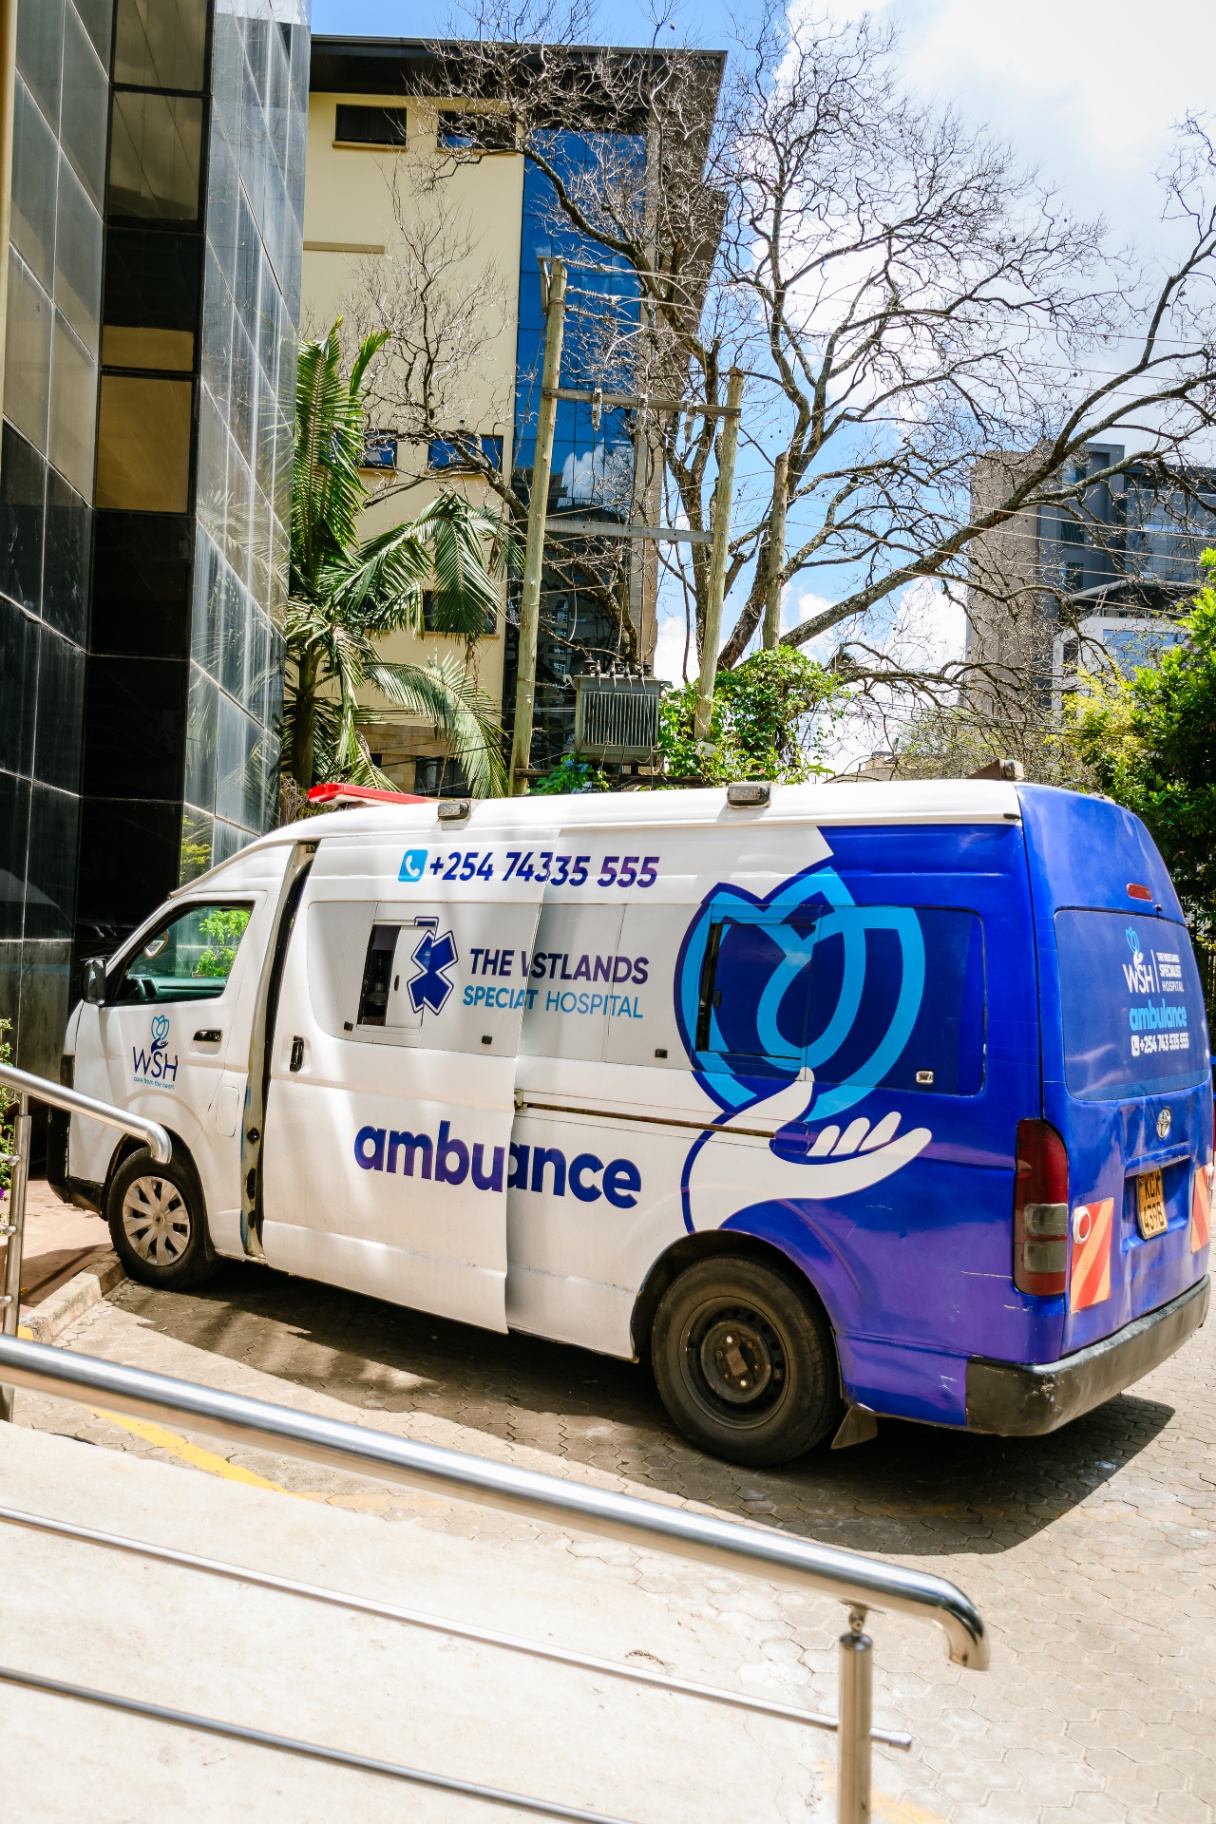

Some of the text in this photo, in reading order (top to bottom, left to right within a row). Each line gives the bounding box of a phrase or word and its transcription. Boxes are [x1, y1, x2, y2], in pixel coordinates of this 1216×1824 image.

[430, 852, 494, 881] +254
[597, 856, 660, 888] 555
[470, 948, 514, 977] THE
[1123, 964, 1154, 993] WSH
[1161, 980, 1185, 992] HOSPITAL
[545, 989, 644, 1019] HOSPITAL
[1129, 998, 1188, 1031] ambulance
[1140, 1035, 1157, 1054] +254
[1157, 1034, 1169, 1052] 743
[132, 1046, 179, 1082] WSH
